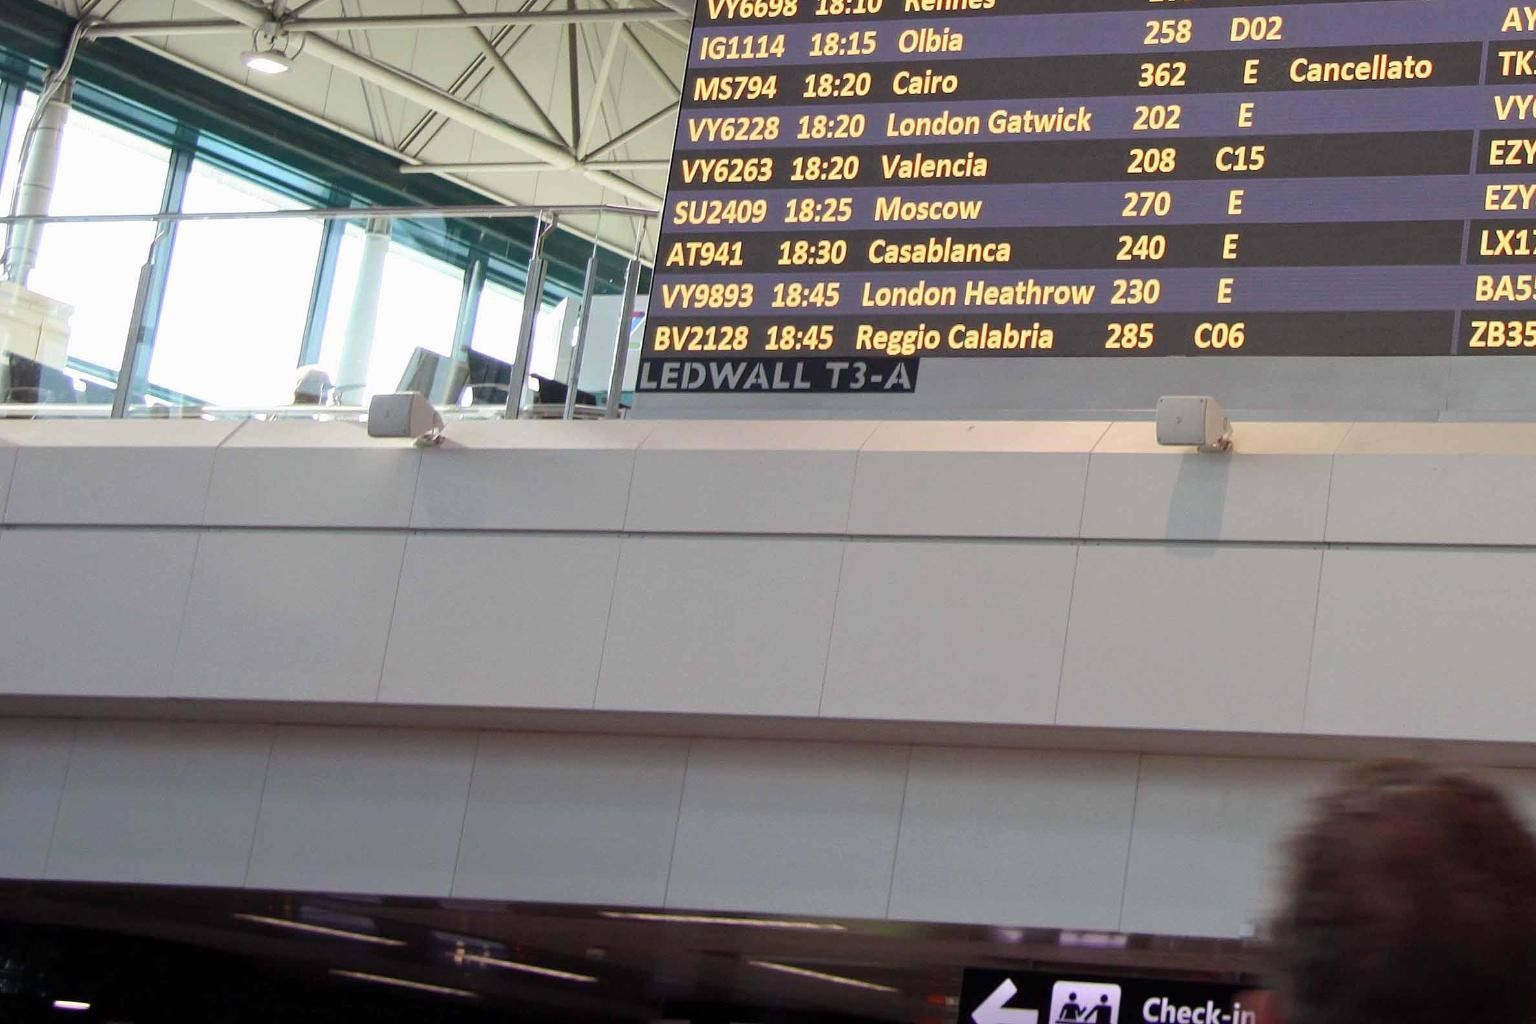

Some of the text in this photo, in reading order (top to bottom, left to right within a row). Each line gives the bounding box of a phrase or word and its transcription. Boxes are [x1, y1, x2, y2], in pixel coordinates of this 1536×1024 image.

[692, 52, 1434, 103] MS794 18:20 Cairo 362 E Cancellato
[680, 144, 1267, 185] VY6263 18:20 Valencia 208 C15
[664, 232, 1241, 268] AT941 18:30 Casablanca 240 E
[652, 321, 1246, 356] BV2128 18:45 Reggio Calabria 285 C06
[639, 361, 912, 390] LEDWALL T3-A
[1141, 996, 1257, 1024] Check-in
